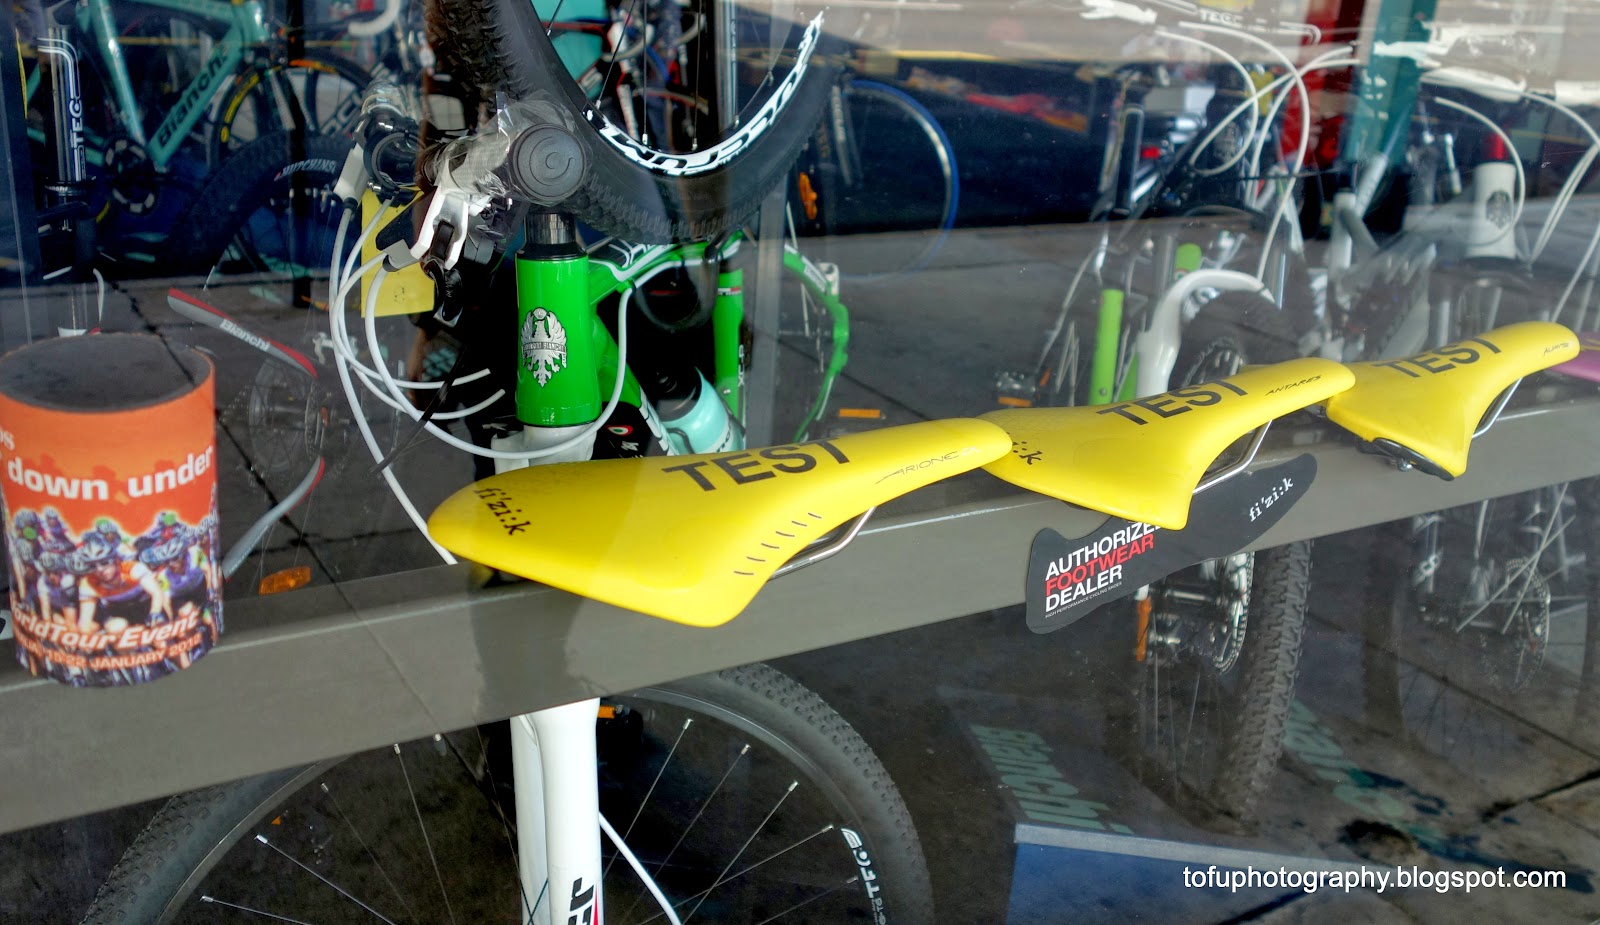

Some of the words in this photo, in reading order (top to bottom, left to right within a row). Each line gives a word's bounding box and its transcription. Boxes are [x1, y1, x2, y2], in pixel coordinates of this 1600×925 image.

[219, 318, 272, 353] Bianchi
[1372, 337, 1503, 378] TEST
[1095, 379, 1249, 426] TEST
[1265, 375, 1323, 396] ANTARES
[7, 457, 109, 500] down
[128, 445, 214, 498] under
[661, 437, 850, 492] TEST
[1045, 521, 1161, 581] AUTHORIZE
[1045, 533, 1154, 596] FOOTWEAR
[1045, 564, 1122, 612] DEALER
[13, 606, 117, 650] orldTour
[118, 611, 200, 649] Event
[90, 650, 167, 670] JANUARY
